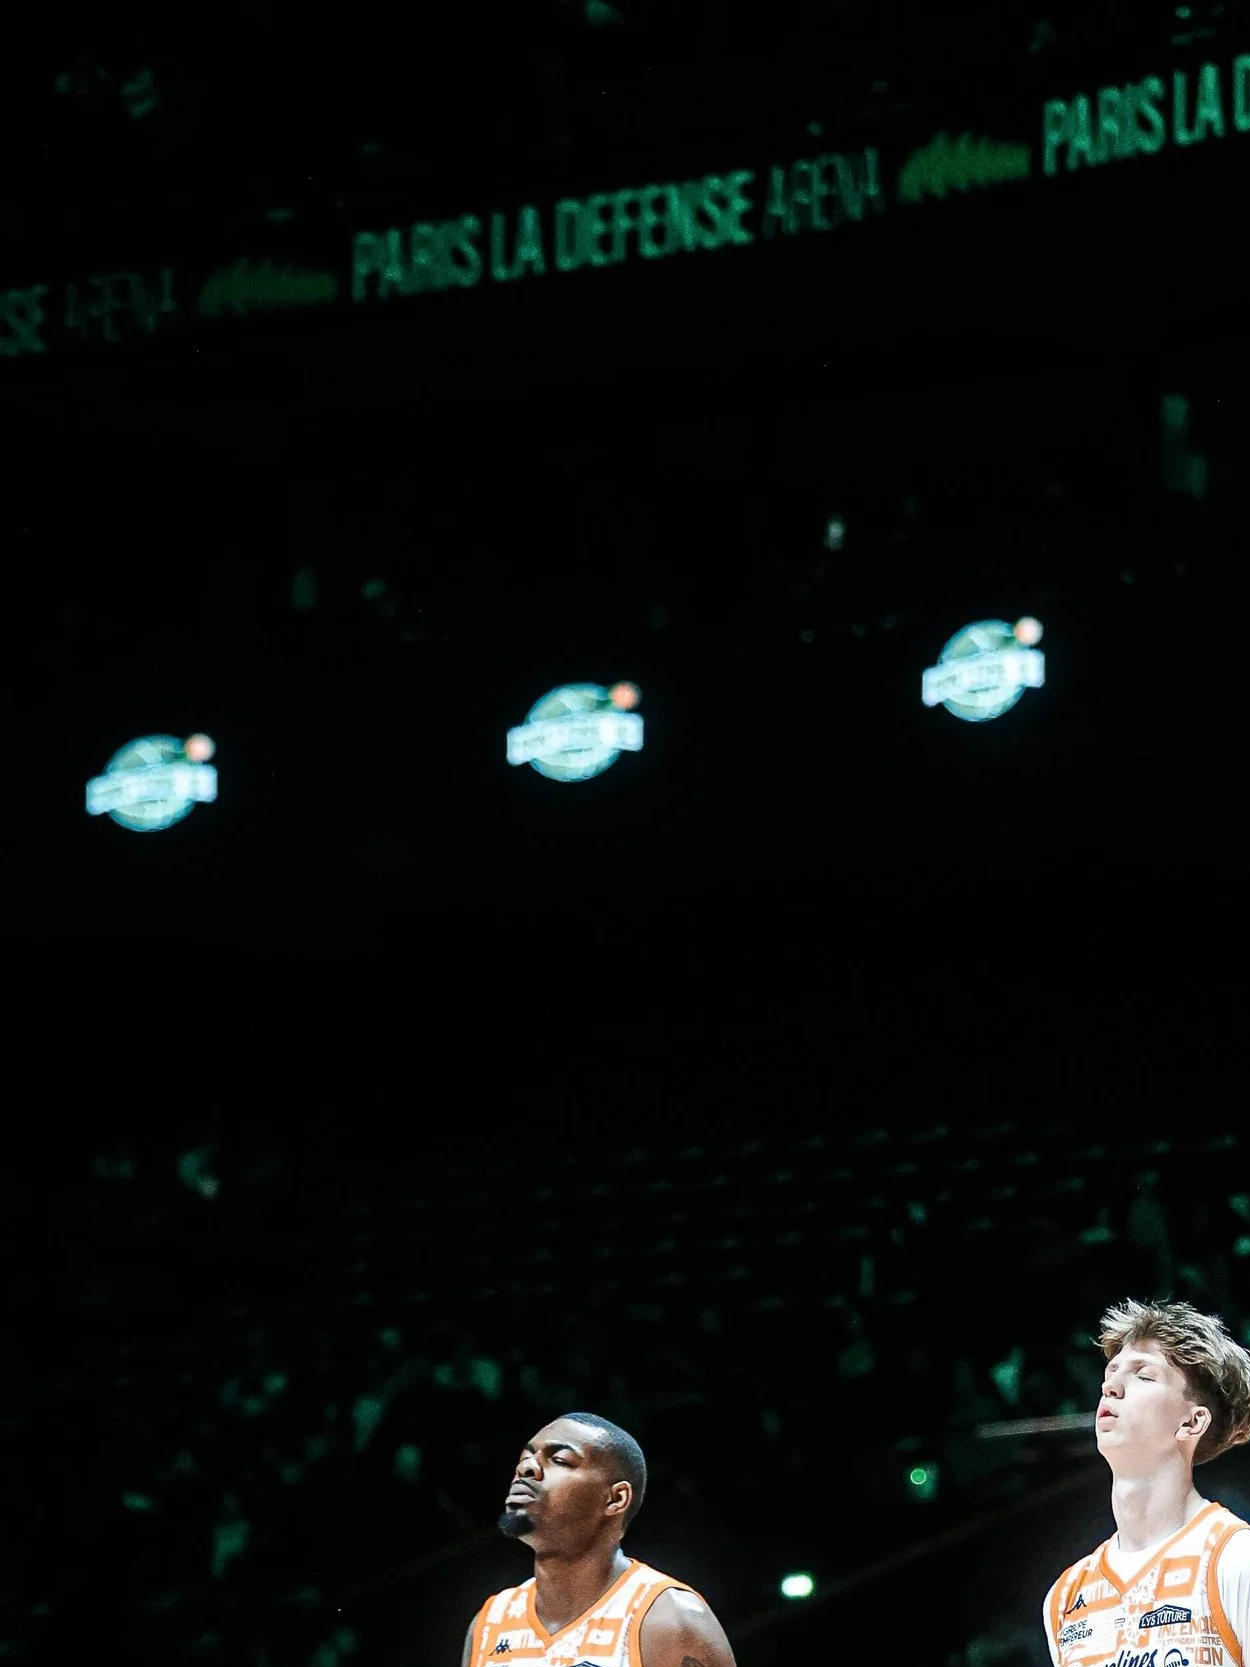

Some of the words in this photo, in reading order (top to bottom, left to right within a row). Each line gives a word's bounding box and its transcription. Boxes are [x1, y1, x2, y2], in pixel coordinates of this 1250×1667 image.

[1042, 75, 1166, 178] PARIS
[1171, 64, 1227, 148] LA
[350, 213, 482, 304] PARIS
[488, 203, 546, 282] LA
[552, 168, 755, 273] DEFENSE
